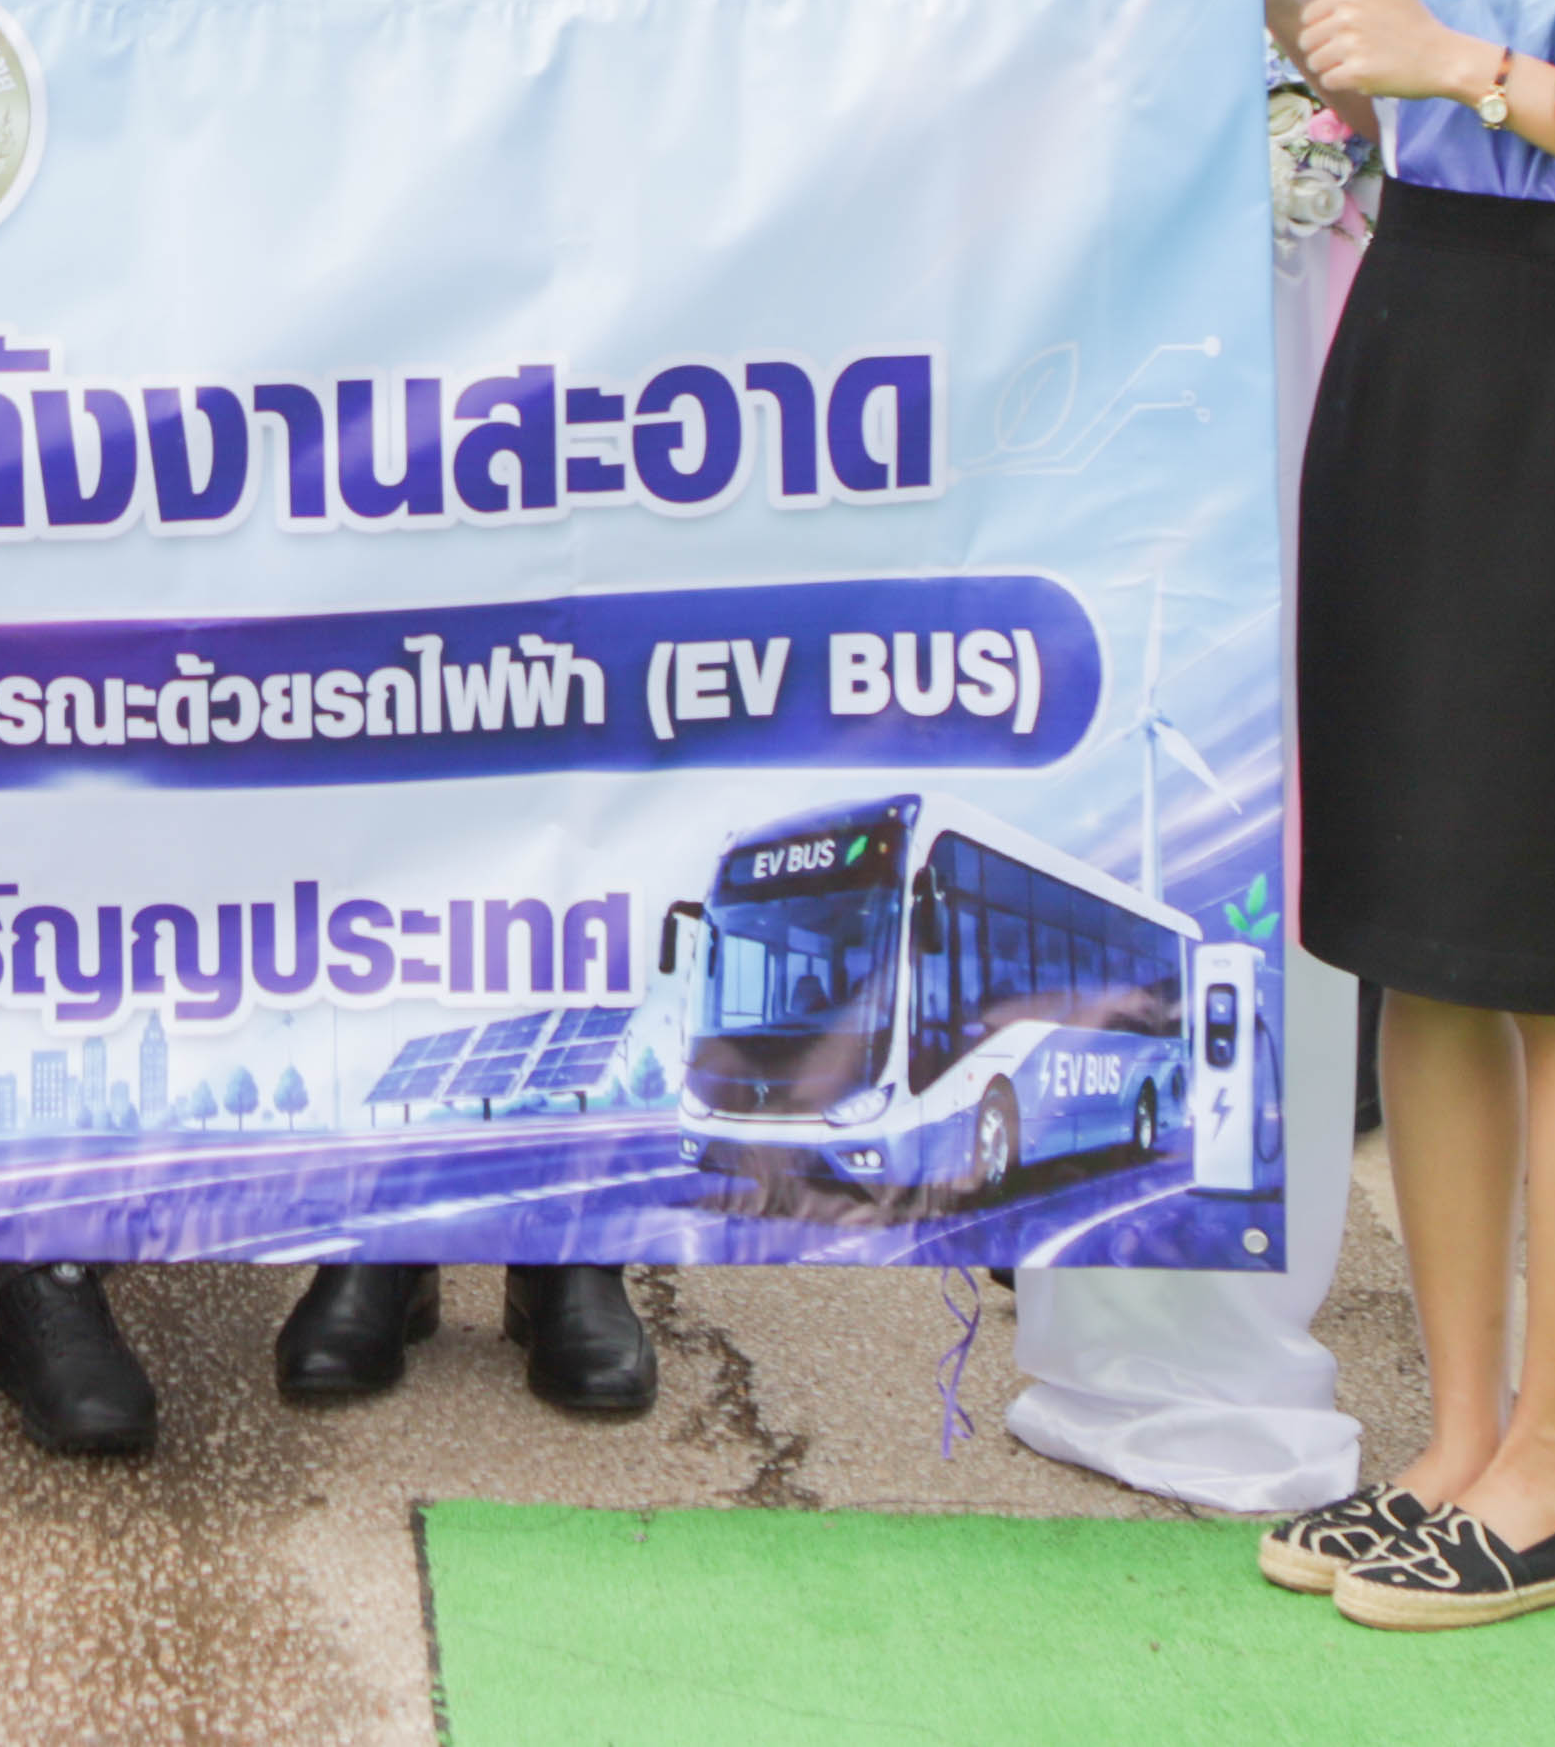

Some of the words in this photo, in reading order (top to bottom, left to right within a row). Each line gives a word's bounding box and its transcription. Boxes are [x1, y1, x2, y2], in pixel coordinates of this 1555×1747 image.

[647, 637, 790, 739] (EV
[830, 629, 1041, 735] BUS)
[753, 847, 785, 879] EV
[786, 838, 836, 873] BUS
[1054, 1052, 1083, 1097] EV
[1084, 1053, 1122, 1096] BUS
